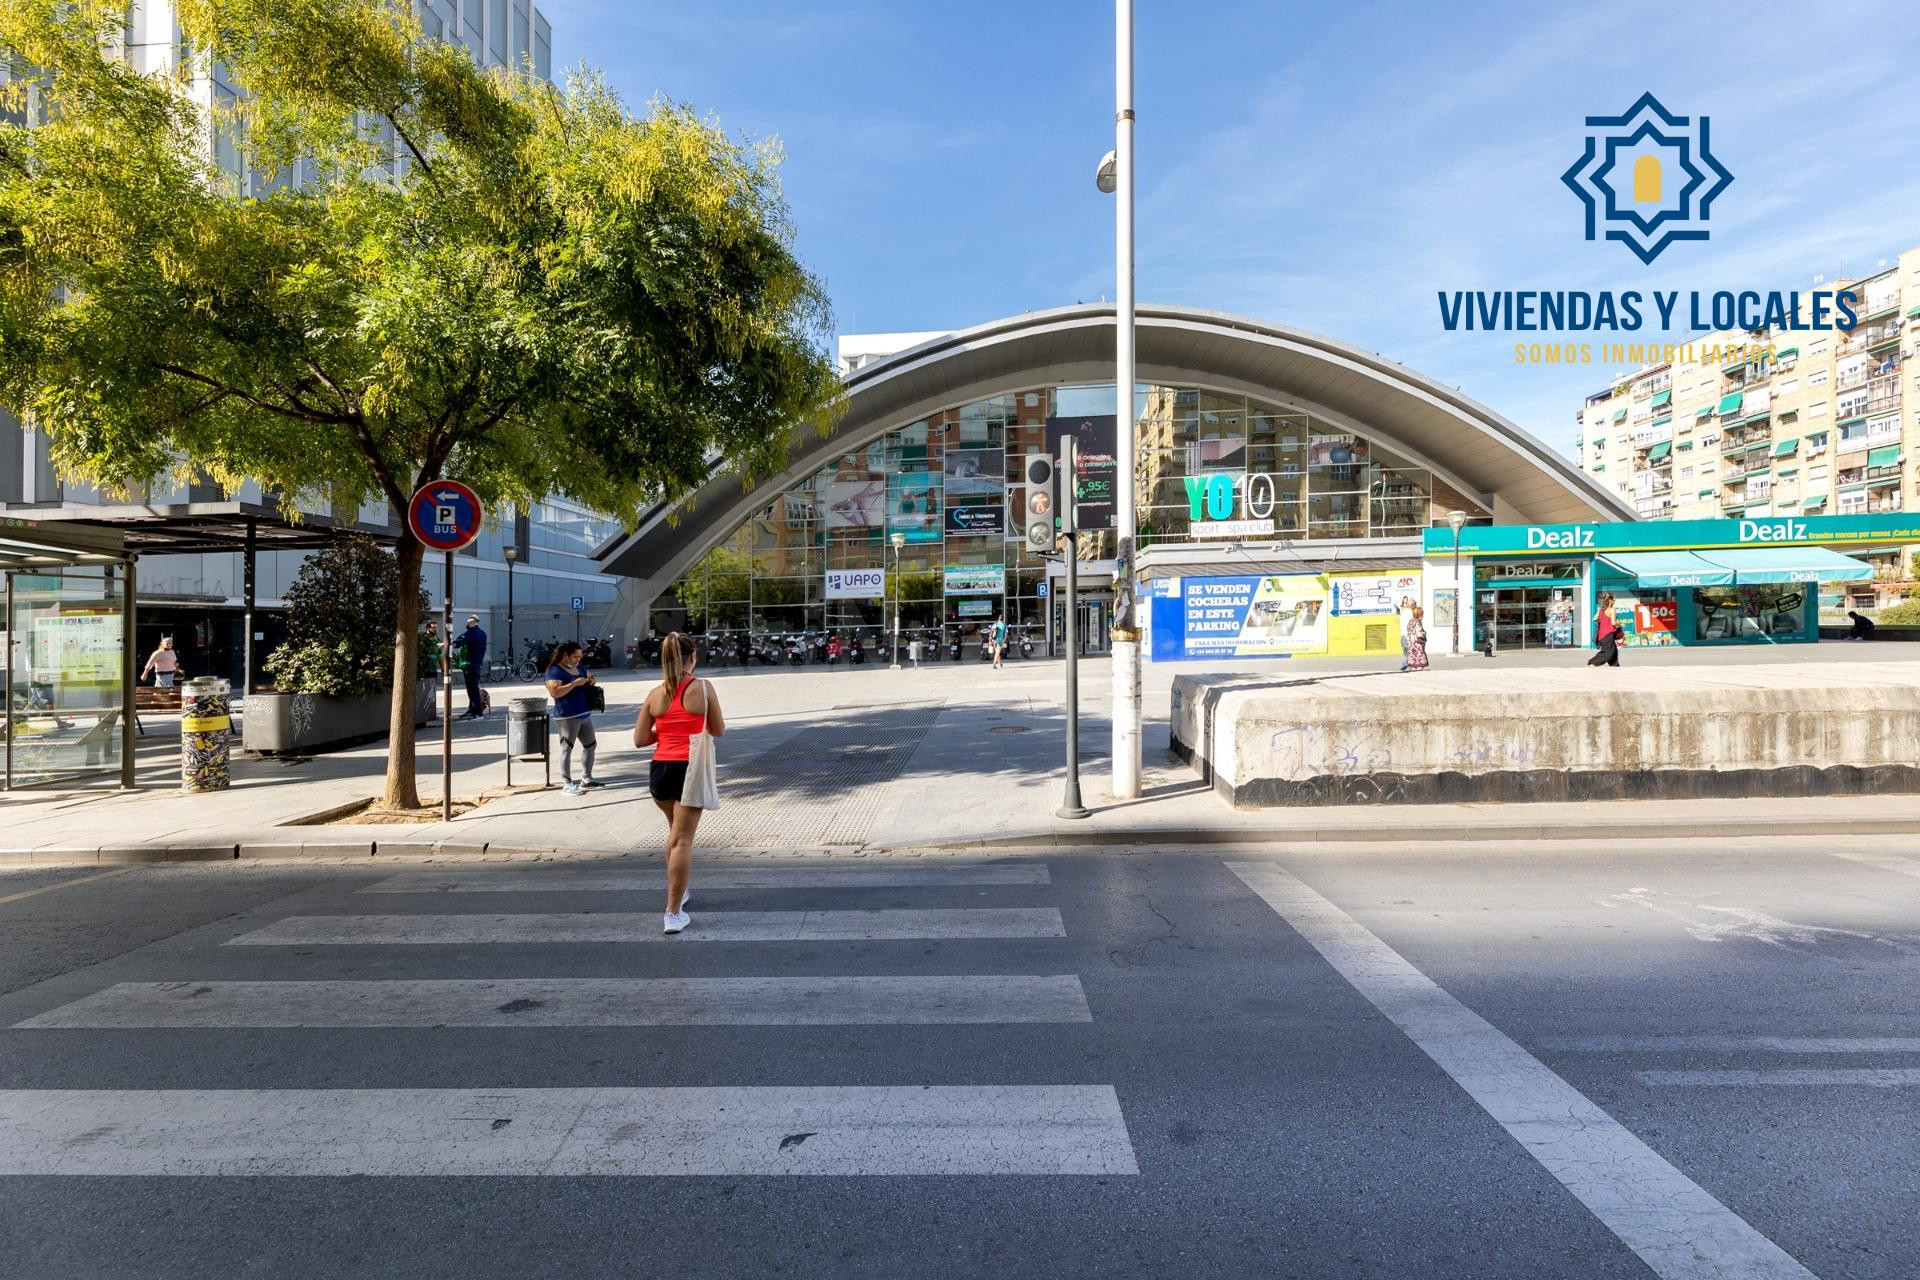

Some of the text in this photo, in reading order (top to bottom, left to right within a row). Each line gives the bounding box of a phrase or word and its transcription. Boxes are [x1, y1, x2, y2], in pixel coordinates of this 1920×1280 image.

[440, 508, 451, 522] P
[434, 525, 457, 534] BUS
[1192, 521, 1273, 535] sport spa club
[1739, 519, 1807, 542] Dealz
[1528, 526, 1595, 549] Dealz
[1808, 532, 1833, 540] Grandes
[1505, 565, 1546, 578] Dealz
[1790, 571, 1820, 582] Dealz
[844, 574, 881, 586] UAPO
[1670, 575, 1701, 586] Dealz
[1188, 583, 1251, 595] SE VENDEN
[1188, 597, 1248, 607] COCHERAS
[1188, 609, 1235, 619] EN ESTE
[1188, 621, 1240, 632] PARKING
